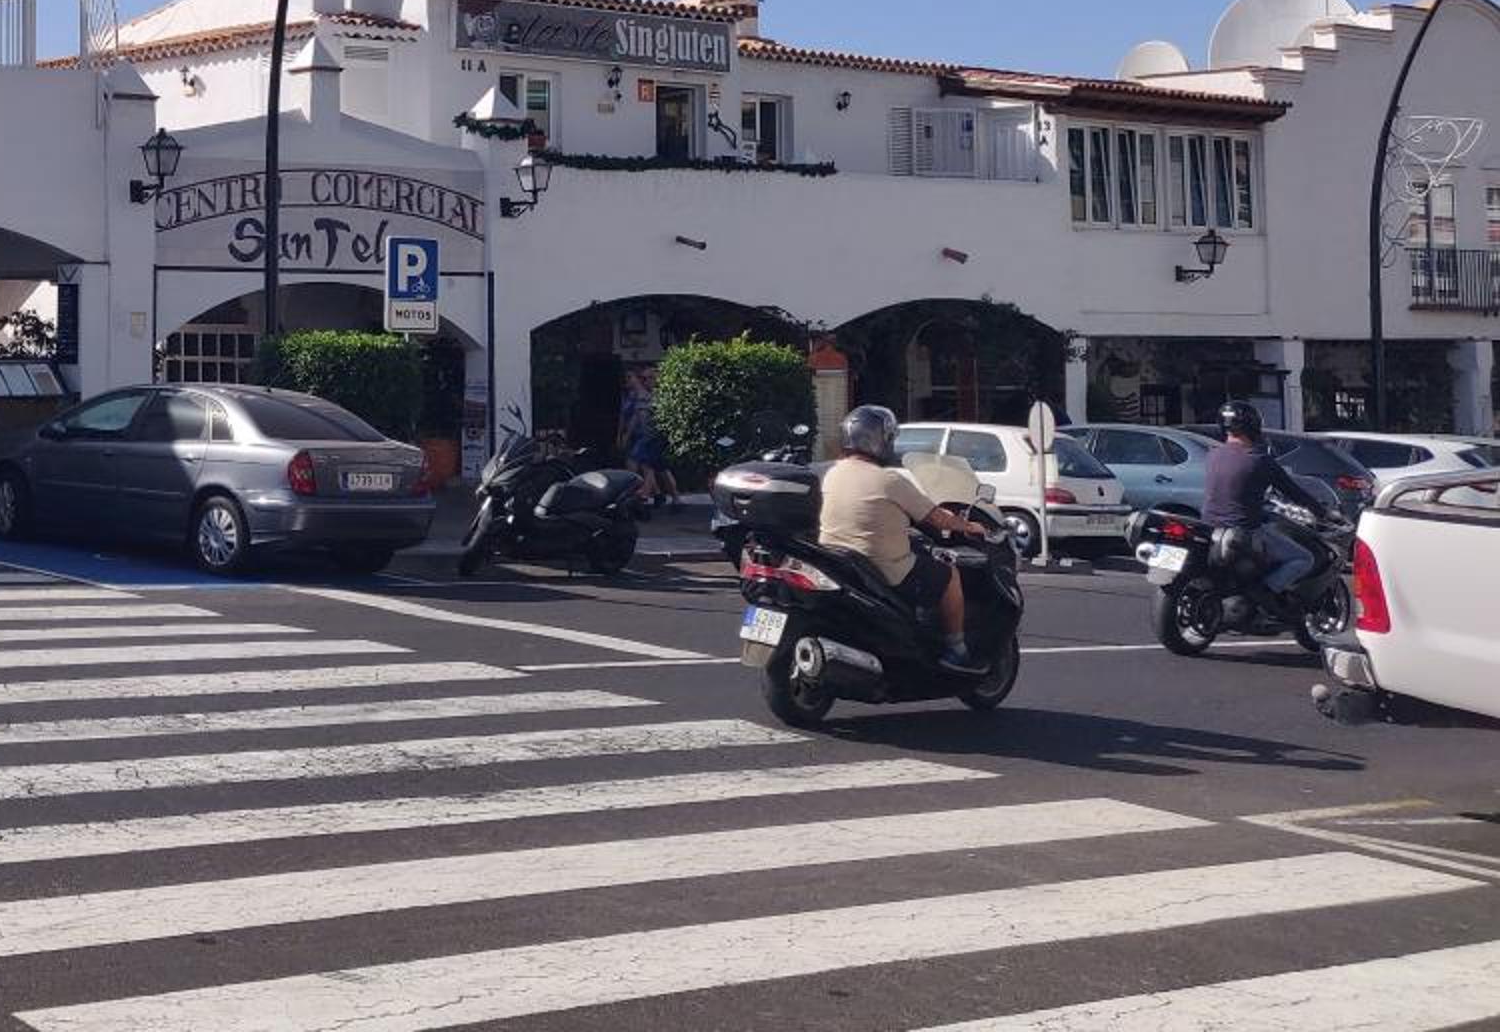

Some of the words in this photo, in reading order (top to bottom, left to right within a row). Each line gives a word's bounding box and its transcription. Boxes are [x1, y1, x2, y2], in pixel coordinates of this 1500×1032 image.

[615, 18, 727, 65] Singluten
[477, 60, 487, 73] A
[155, 172, 281, 231] CENTR
[397, 243, 428, 293] P
[395, 309, 432, 321] MOTOS
